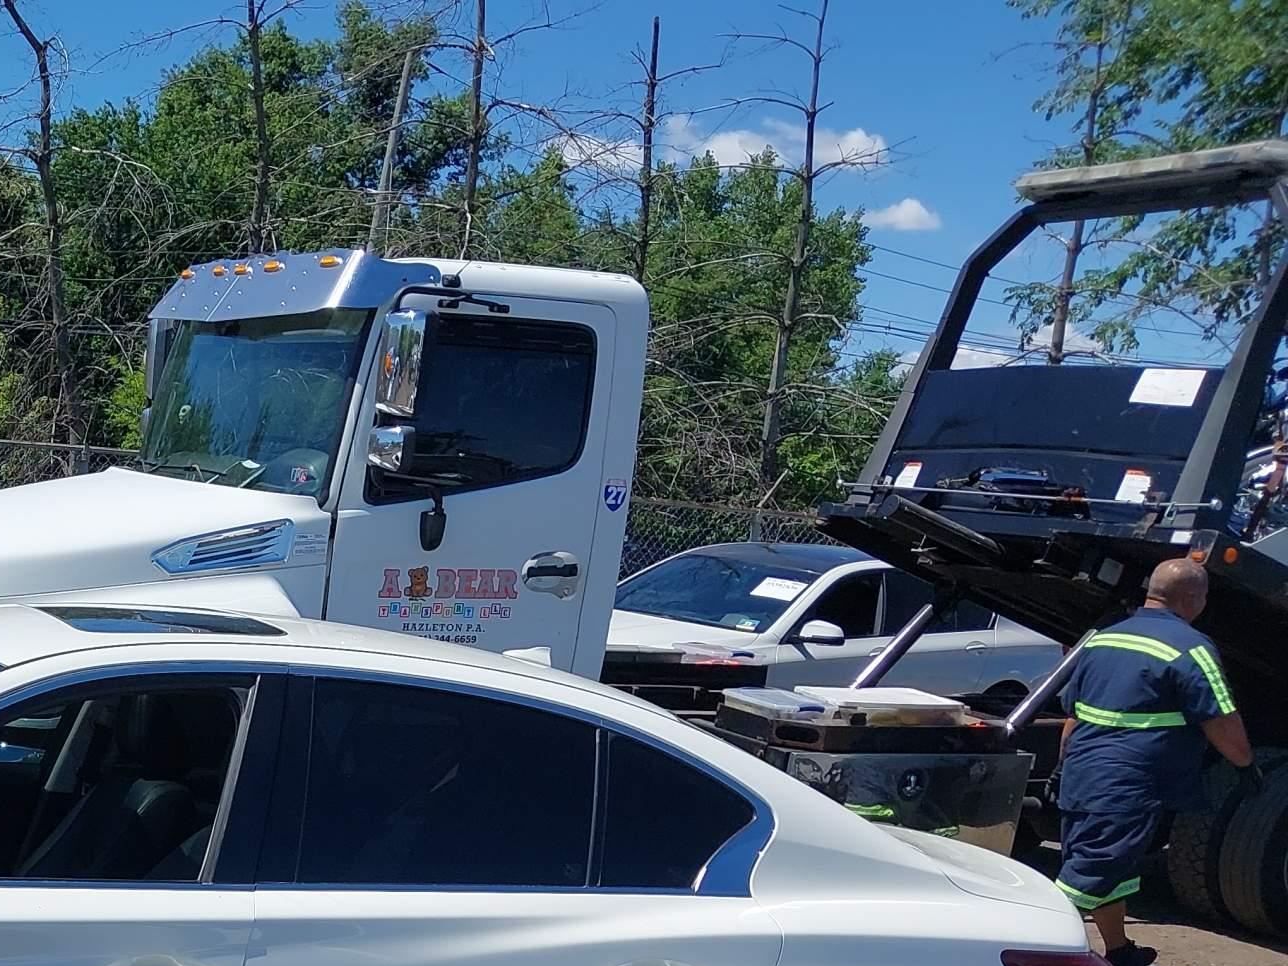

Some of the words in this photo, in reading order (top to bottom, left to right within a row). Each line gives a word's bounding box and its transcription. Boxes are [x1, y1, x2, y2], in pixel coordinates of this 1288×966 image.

[606, 486, 627, 505] 27
[378, 568, 402, 598] A
[434, 568, 518, 599] BEAR
[378, 602, 475, 618] TRANSPORT
[480, 603, 511, 618] LLC
[402, 622, 463, 632] HAZLETON
[465, 623, 486, 633] P.A.
